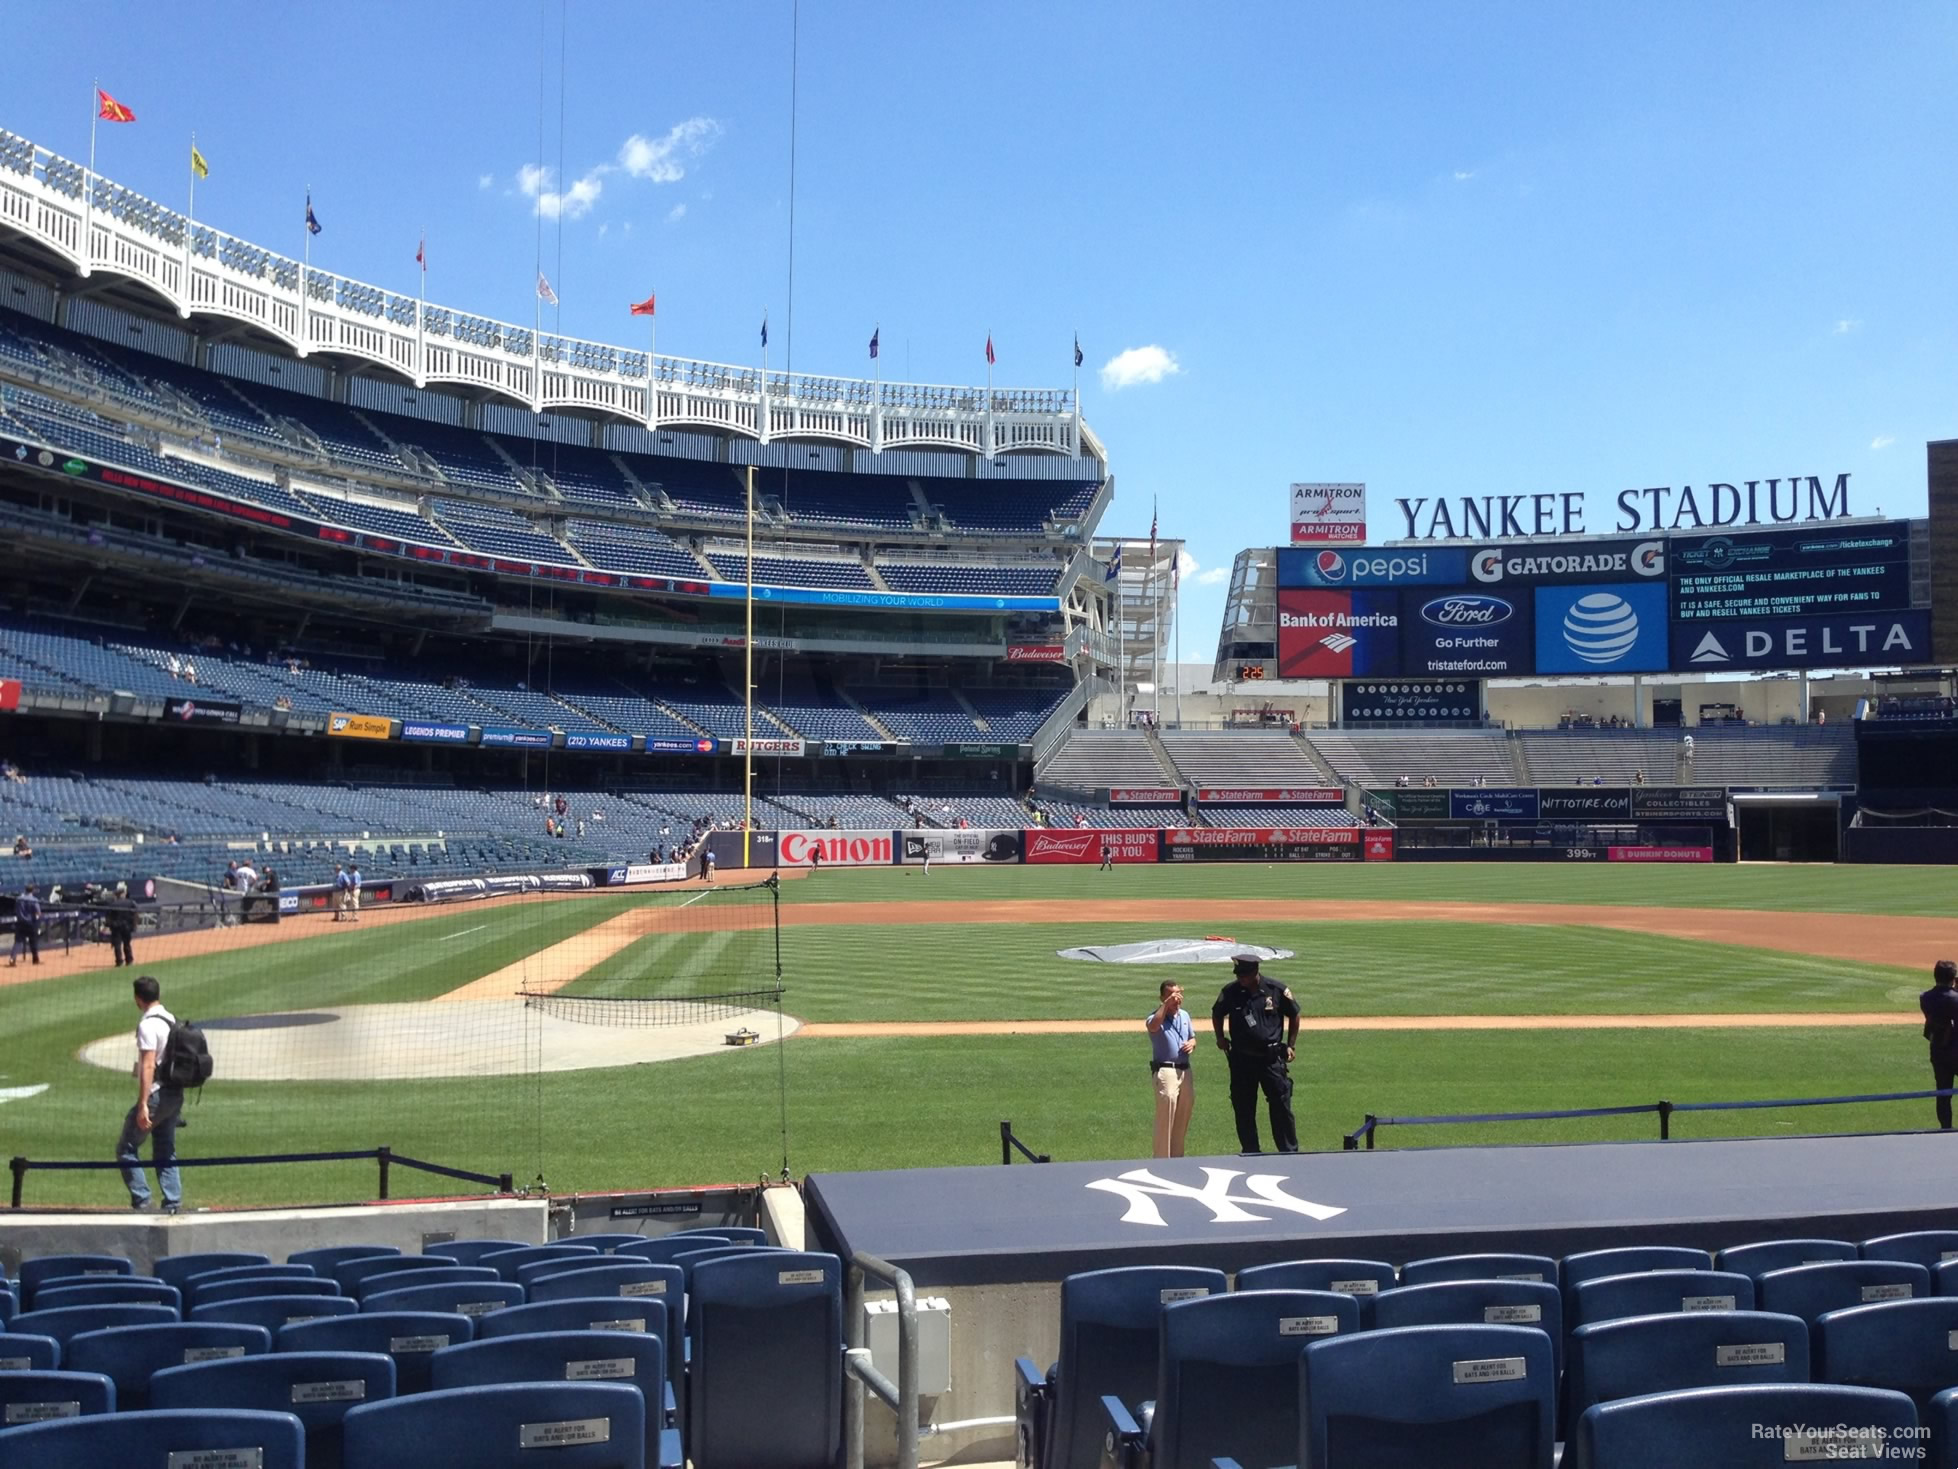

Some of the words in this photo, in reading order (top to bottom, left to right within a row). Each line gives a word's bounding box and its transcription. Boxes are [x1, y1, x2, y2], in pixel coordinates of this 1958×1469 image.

[1295, 489, 1362, 498] ARMITRON
[1395, 492, 1586, 539] YANKEE
[1616, 473, 1852, 533] STADIUM
[1299, 525, 1359, 534] ARMITRON
[1352, 553, 1427, 581] pepsi
[1507, 554, 1626, 575] GATORADE
[1695, 577, 1712, 585] ONLY
[1714, 575, 1744, 584] OFFICIAL
[1746, 574, 1772, 582] RESALE
[1774, 570, 1824, 580] MARKETPLACE
[1853, 566, 1885, 575] YANKEES
[1680, 586, 1694, 594] AND
[1696, 584, 1745, 592] YANKEES.COM
[823, 593, 878, 604] MOBILIZING
[880, 596, 906, 605] YOUR
[908, 597, 944, 607] WORLD
[1724, 599, 1752, 607] SECURE
[1754, 598, 1769, 606] AND
[1770, 596, 1814, 605] CONVENIENT
[1438, 600, 1494, 623] Ford
[1712, 608, 1738, 616] RESELL
[1739, 607, 1770, 615] YANKEES
[1773, 605, 1801, 614] TICKETS
[1280, 612, 1317, 627] Bank
[1319, 612, 1334, 627] of
[1338, 612, 1398, 627] America
[722, 637, 746, 646] Audi
[1435, 638, 1453, 648] Go
[1455, 637, 1499, 648] Further
[1746, 624, 1913, 657] DELTA
[1008, 648, 1063, 659] Budweiser
[1428, 660, 1507, 671] tristateford.com
[350, 720, 363, 730] Run
[365, 722, 386, 734] Simple
[405, 726, 434, 737] LEGENDS
[435, 728, 466, 739] PREMIER
[568, 736, 587, 746] (212)
[589, 737, 628, 747] YANKEES
[1541, 797, 1628, 808] NITTOTIRE.COM
[1100, 834, 1123, 844] THIS
[1125, 833, 1155, 845] BUD'S
[780, 833, 892, 863] Canon
[1035, 840, 1087, 851] Budweiser
[611, 869, 626, 879] ACC
